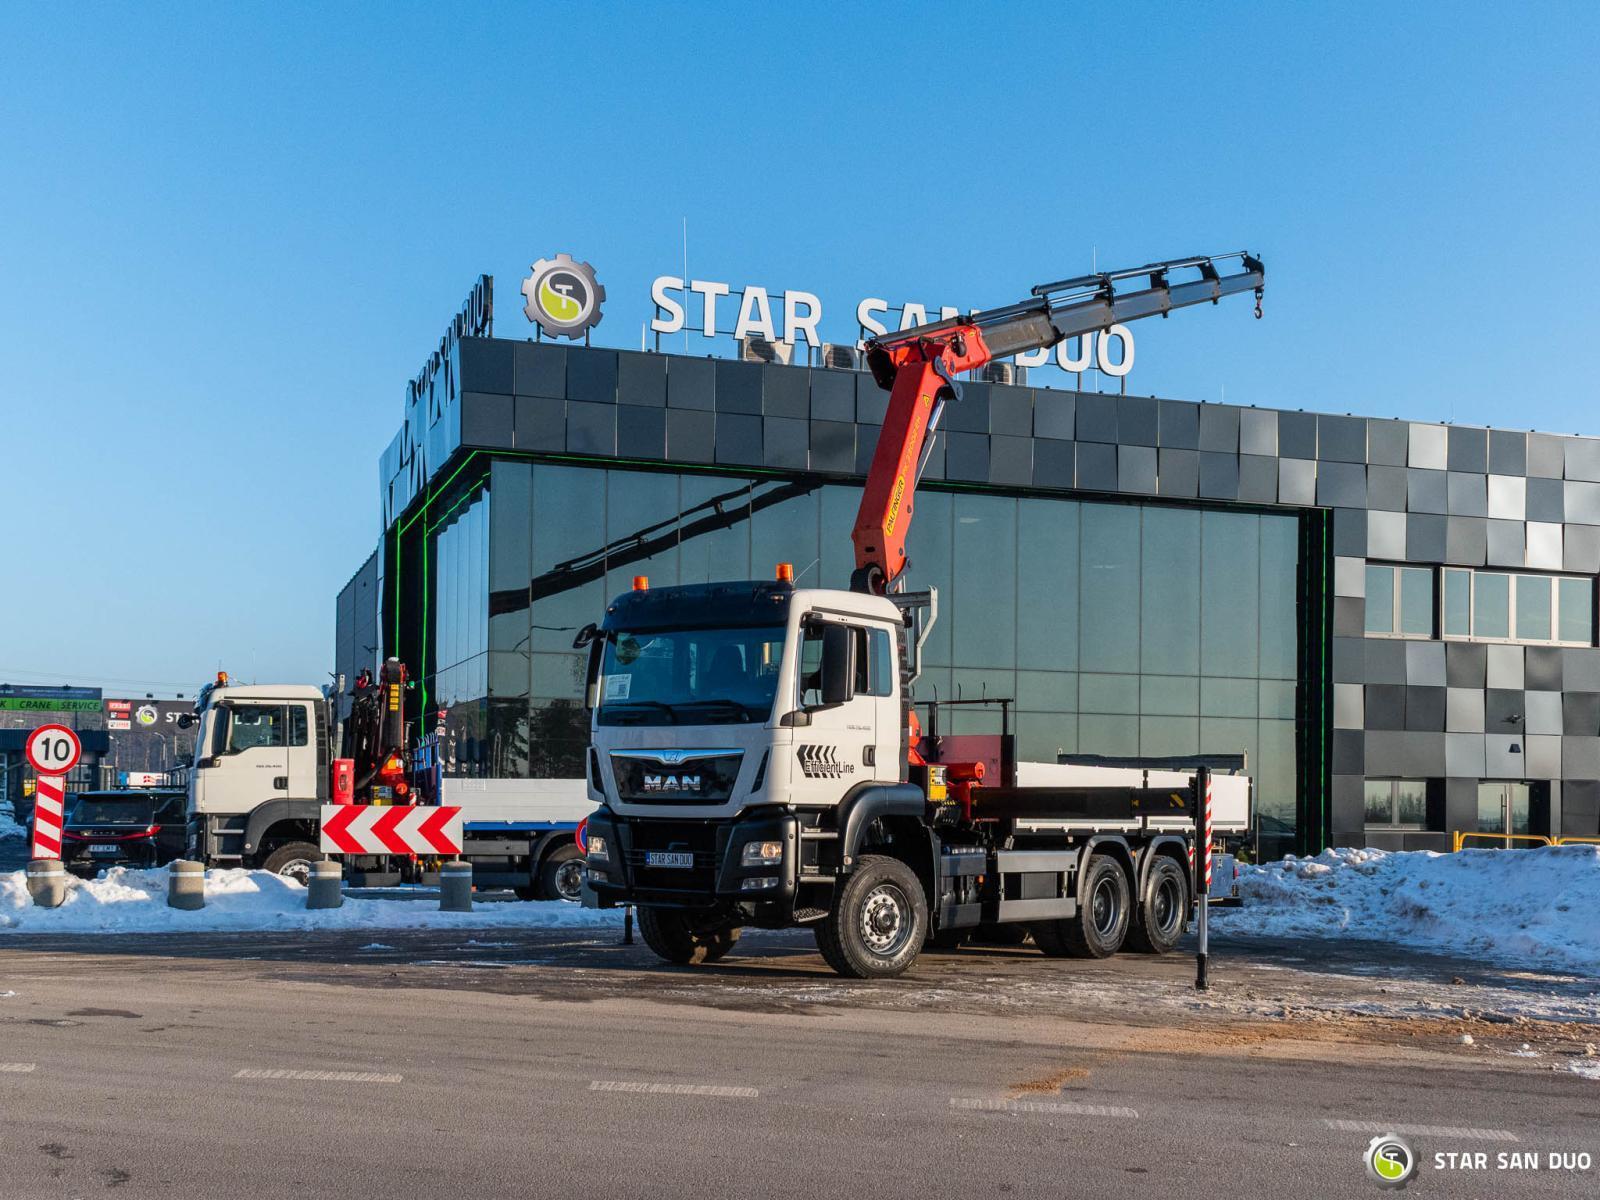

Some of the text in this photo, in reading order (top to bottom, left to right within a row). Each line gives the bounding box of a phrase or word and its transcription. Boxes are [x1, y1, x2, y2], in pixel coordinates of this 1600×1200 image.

[650, 275, 822, 348] STAR
[886, 479, 904, 533] PALFINGER
[20, 701, 52, 709] CRANE
[60, 701, 100, 710] SERVICE
[41, 738, 70, 762] 10
[805, 760, 854, 774] EfficientLine
[644, 775, 701, 791] MAN
[650, 853, 692, 866] STAR SAN DUO
